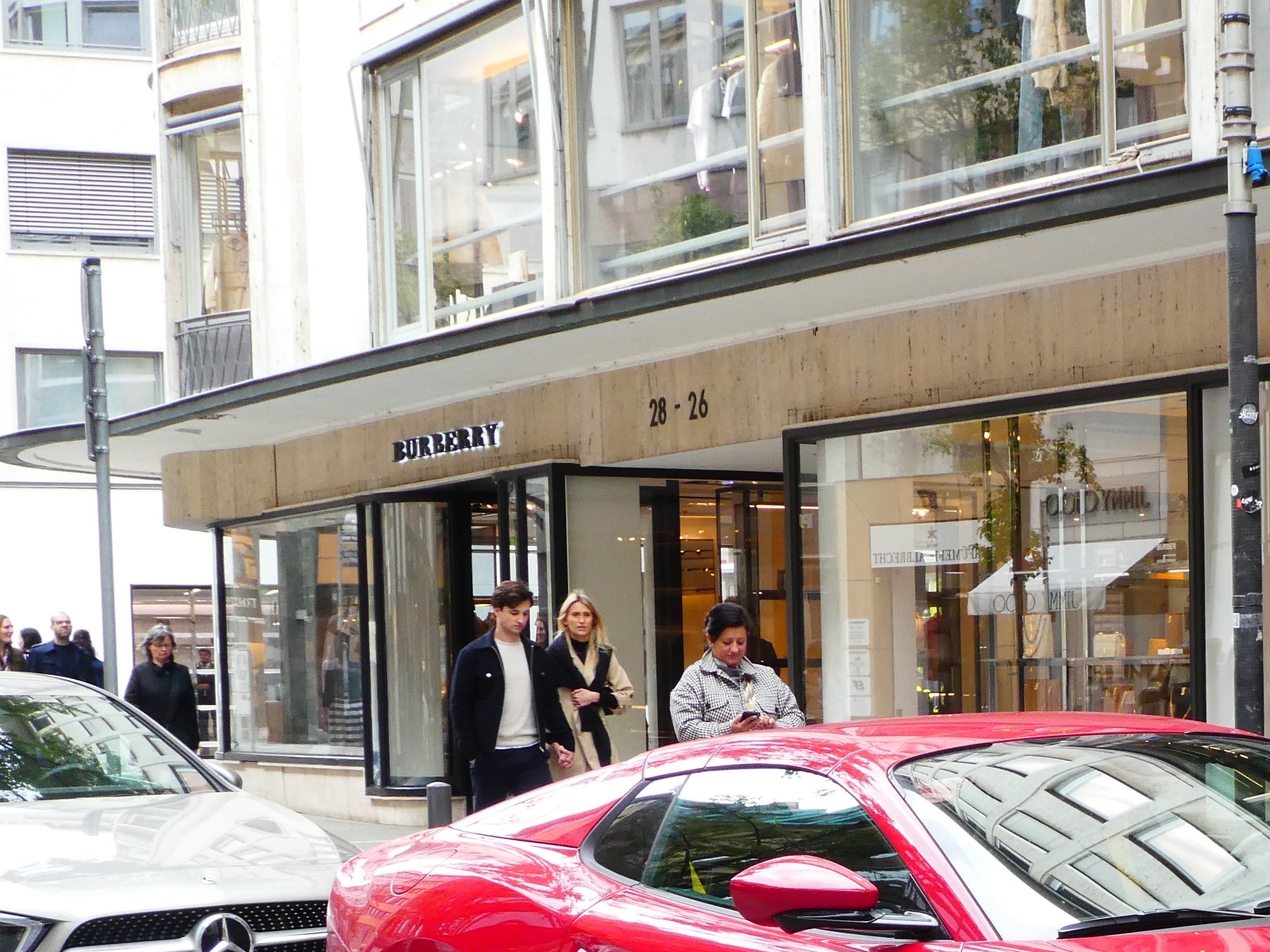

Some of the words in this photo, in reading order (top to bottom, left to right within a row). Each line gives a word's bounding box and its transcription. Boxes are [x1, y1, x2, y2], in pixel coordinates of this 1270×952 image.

[649, 396, 667, 427] 28
[688, 388, 709, 420] 26
[392, 422, 504, 463] BURBERRY
